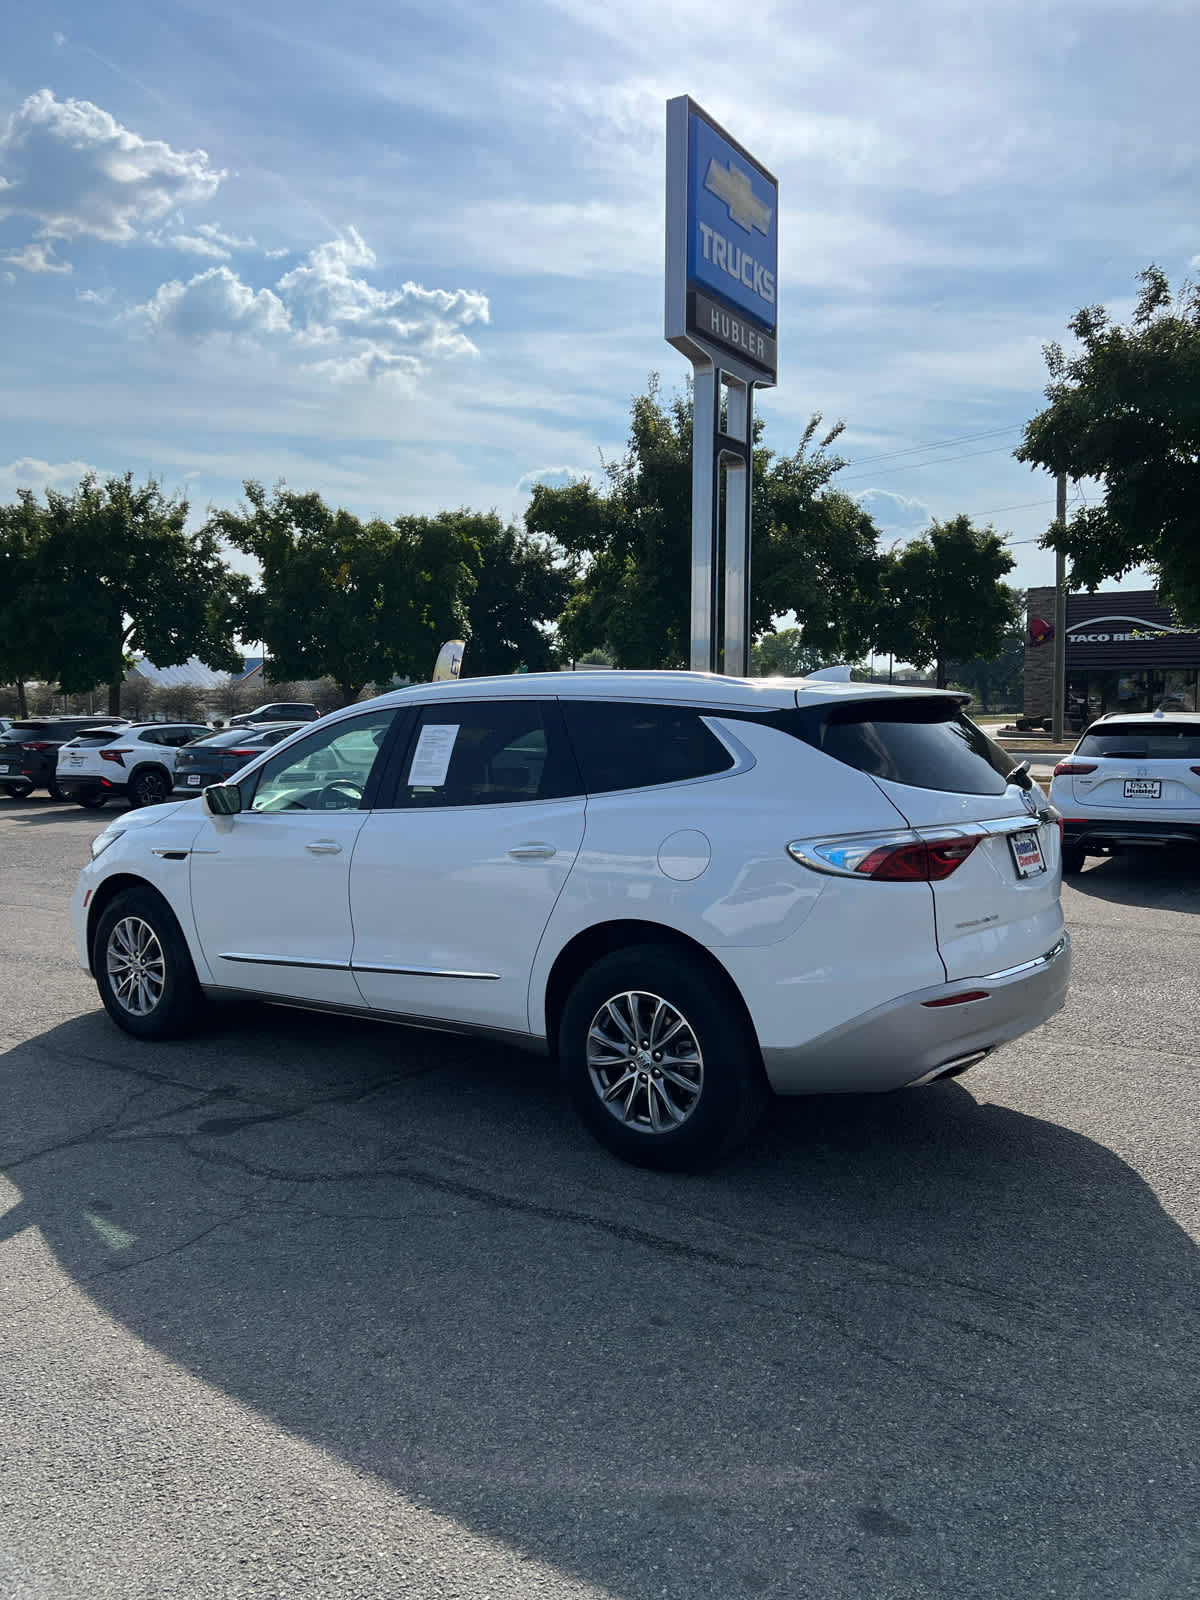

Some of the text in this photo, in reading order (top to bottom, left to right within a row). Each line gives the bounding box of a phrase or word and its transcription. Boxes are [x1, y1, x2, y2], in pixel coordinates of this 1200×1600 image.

[700, 221, 776, 304] TRUCKS
[711, 307, 765, 360] HUBLER
[1068, 634, 1110, 643] TACO
